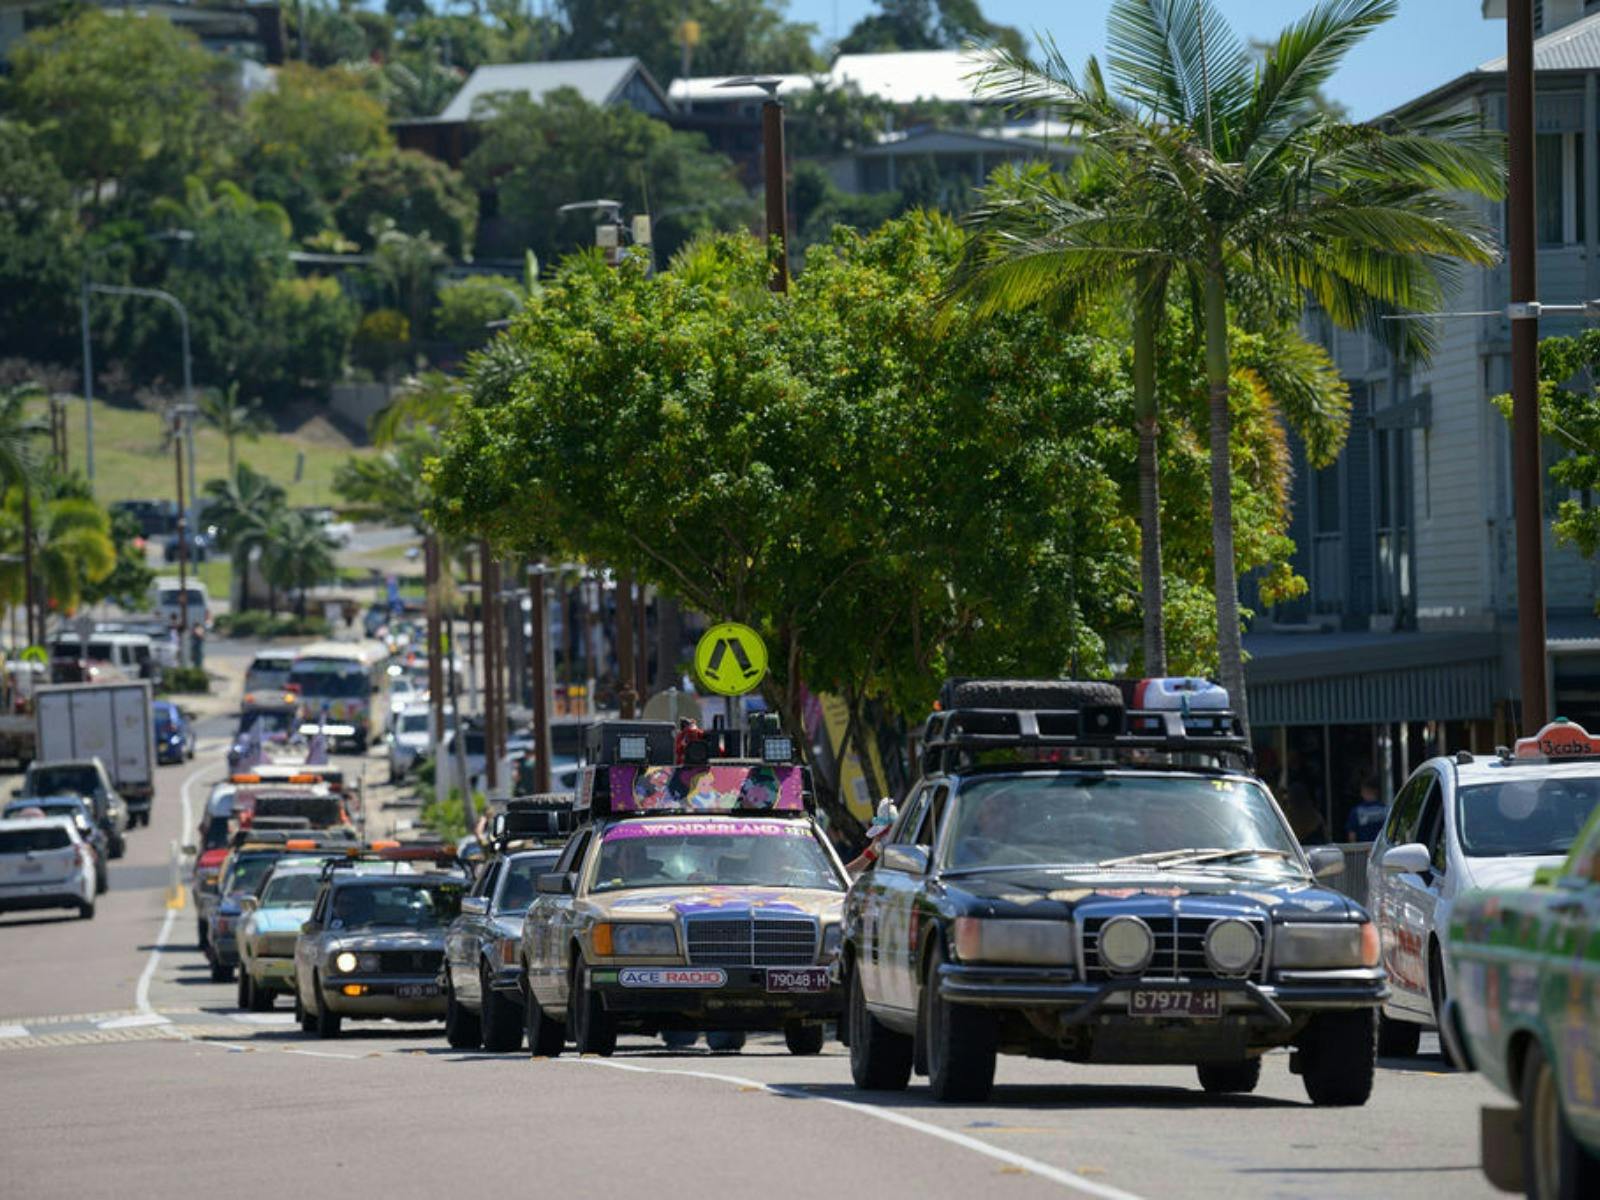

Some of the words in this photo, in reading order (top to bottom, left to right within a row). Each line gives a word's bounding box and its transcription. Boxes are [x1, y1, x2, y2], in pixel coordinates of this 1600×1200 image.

[1537, 738, 1592, 756] 13cabs
[643, 823, 780, 836] WONDERLAND
[625, 972, 660, 984] ACE
[665, 971, 721, 984] RADIO
